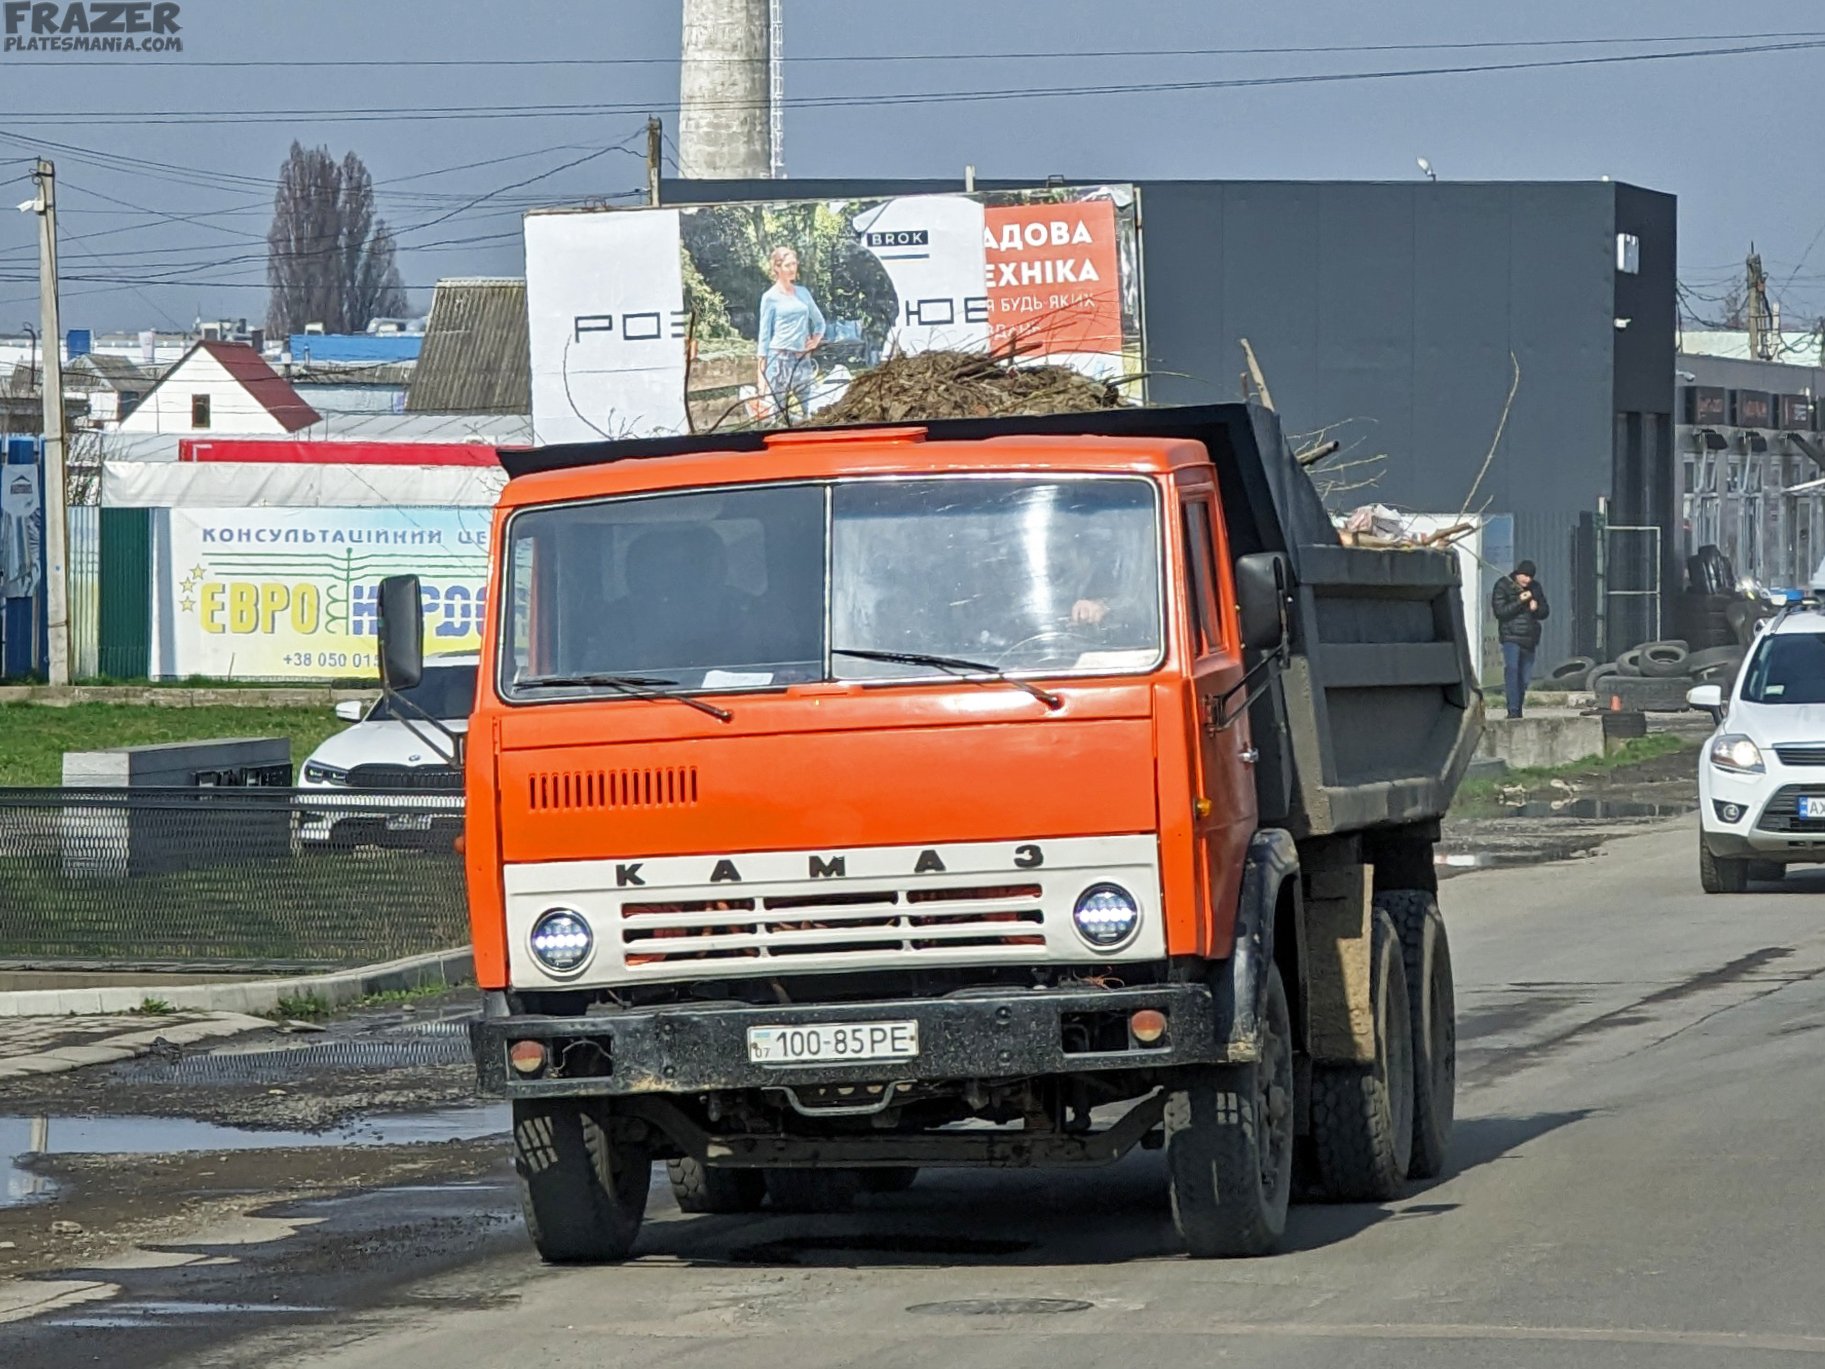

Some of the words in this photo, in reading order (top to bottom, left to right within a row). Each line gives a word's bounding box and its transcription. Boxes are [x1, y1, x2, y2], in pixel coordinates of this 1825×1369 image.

[872, 232, 924, 246] BROK
[1001, 295, 1042, 313] БУДЬ
[202, 527, 442, 545] КОНСУЛЬТАЦІЙНИЙ
[283, 652, 312, 667] +38
[318, 652, 347, 667] 050
[616, 845, 1044, 887] КАМАЗ
